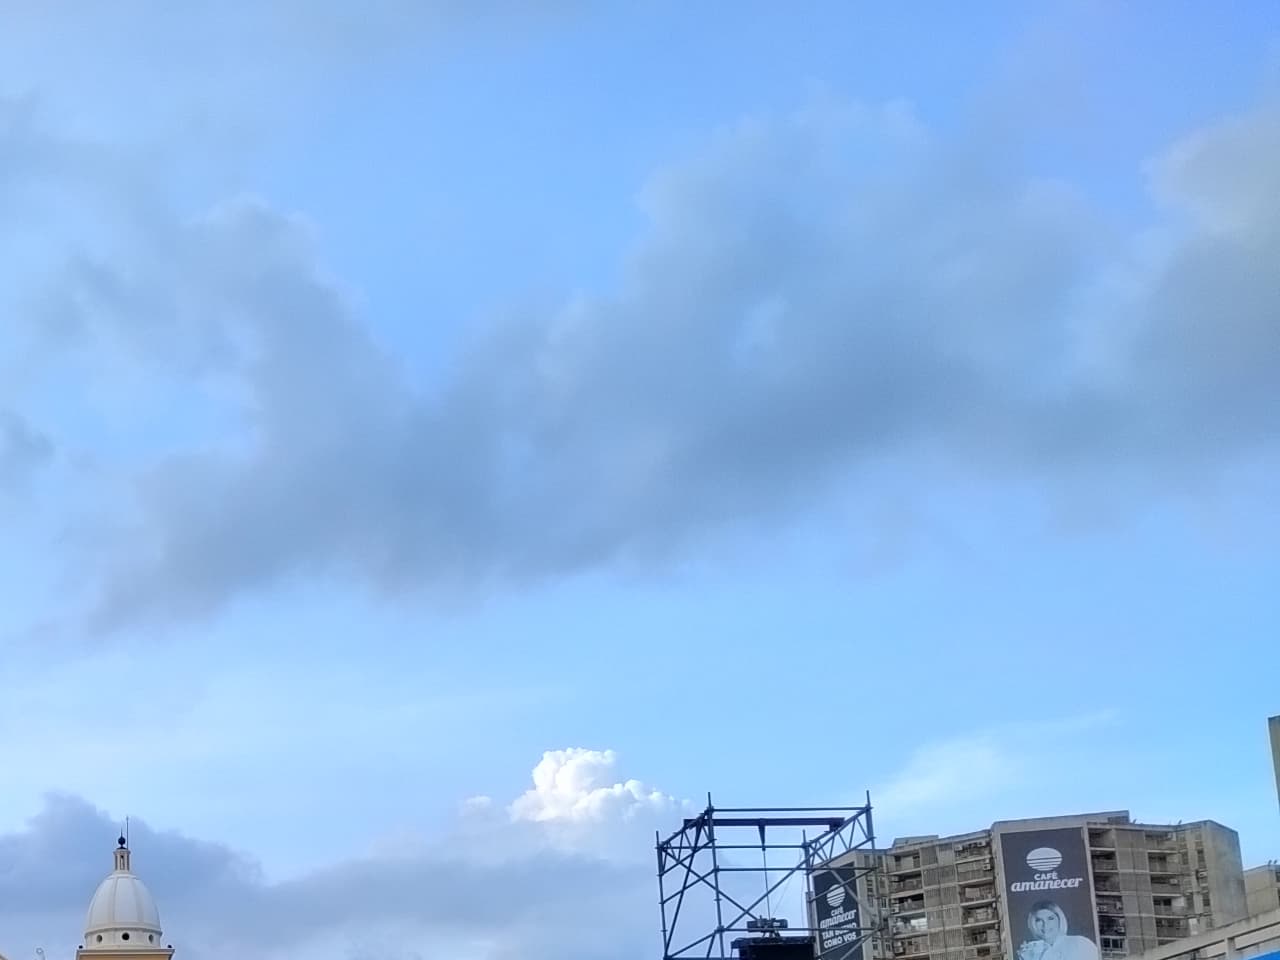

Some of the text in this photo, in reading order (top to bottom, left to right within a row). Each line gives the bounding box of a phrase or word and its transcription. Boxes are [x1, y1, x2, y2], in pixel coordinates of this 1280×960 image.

[1034, 871, 1058, 880] CAFÉ
[1011, 878, 1083, 892] amanecer
[824, 931, 857, 949] COMO VOS
